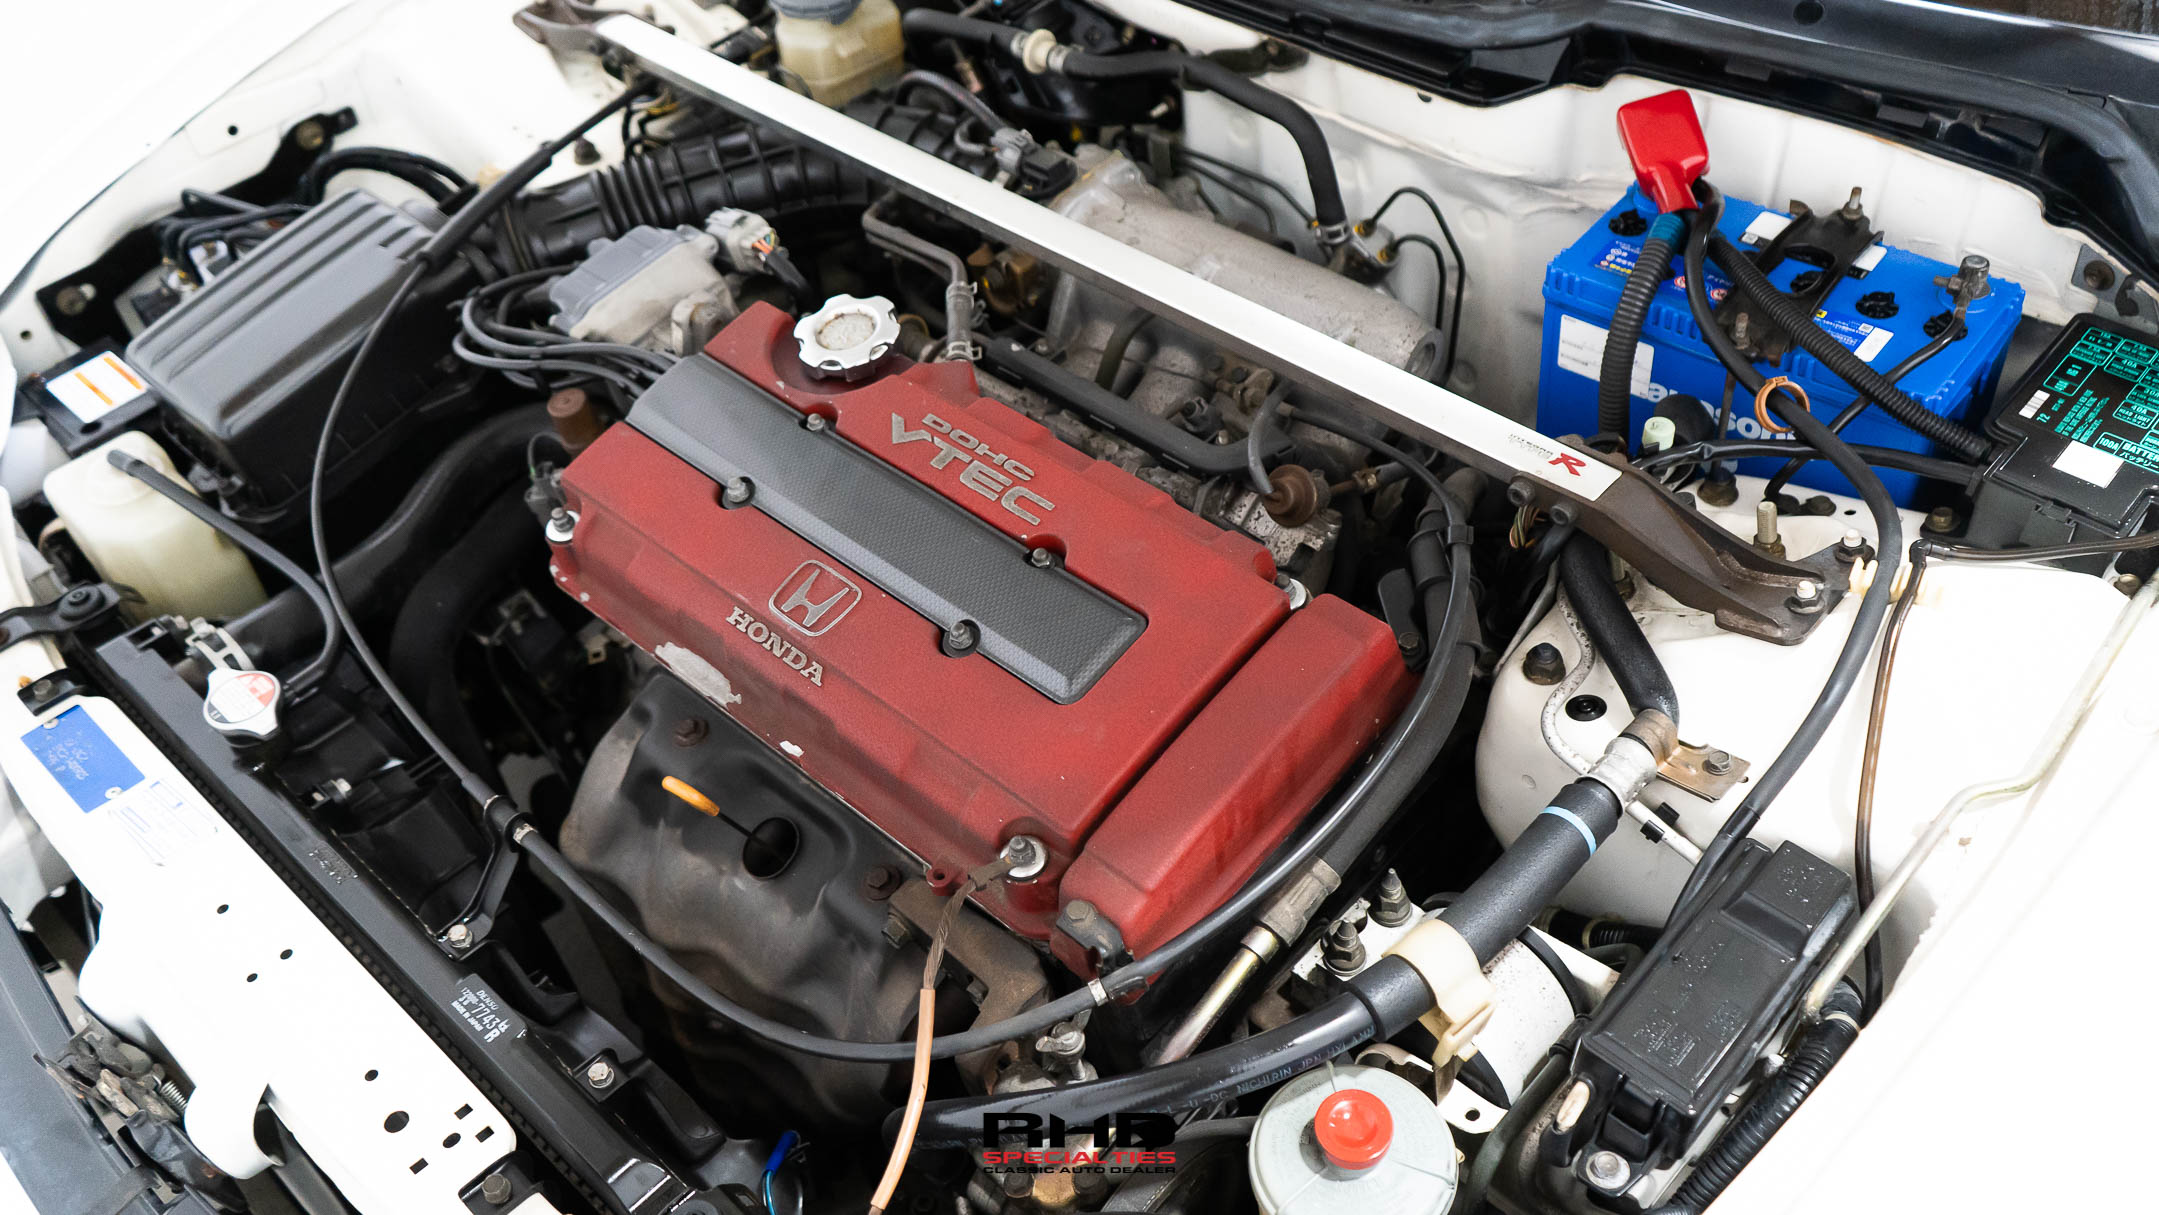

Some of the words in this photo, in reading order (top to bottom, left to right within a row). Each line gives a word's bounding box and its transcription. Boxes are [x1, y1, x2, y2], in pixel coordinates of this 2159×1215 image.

[2130, 405, 2148, 415] 40A
[922, 413, 1035, 482] DOHC
[2099, 437, 2120, 451] 100A
[891, 412, 1056, 526] VTEC
[1547, 452, 1587, 477] R
[725, 606, 824, 687] HONDA
[476, 989, 499, 1011] DENSO
